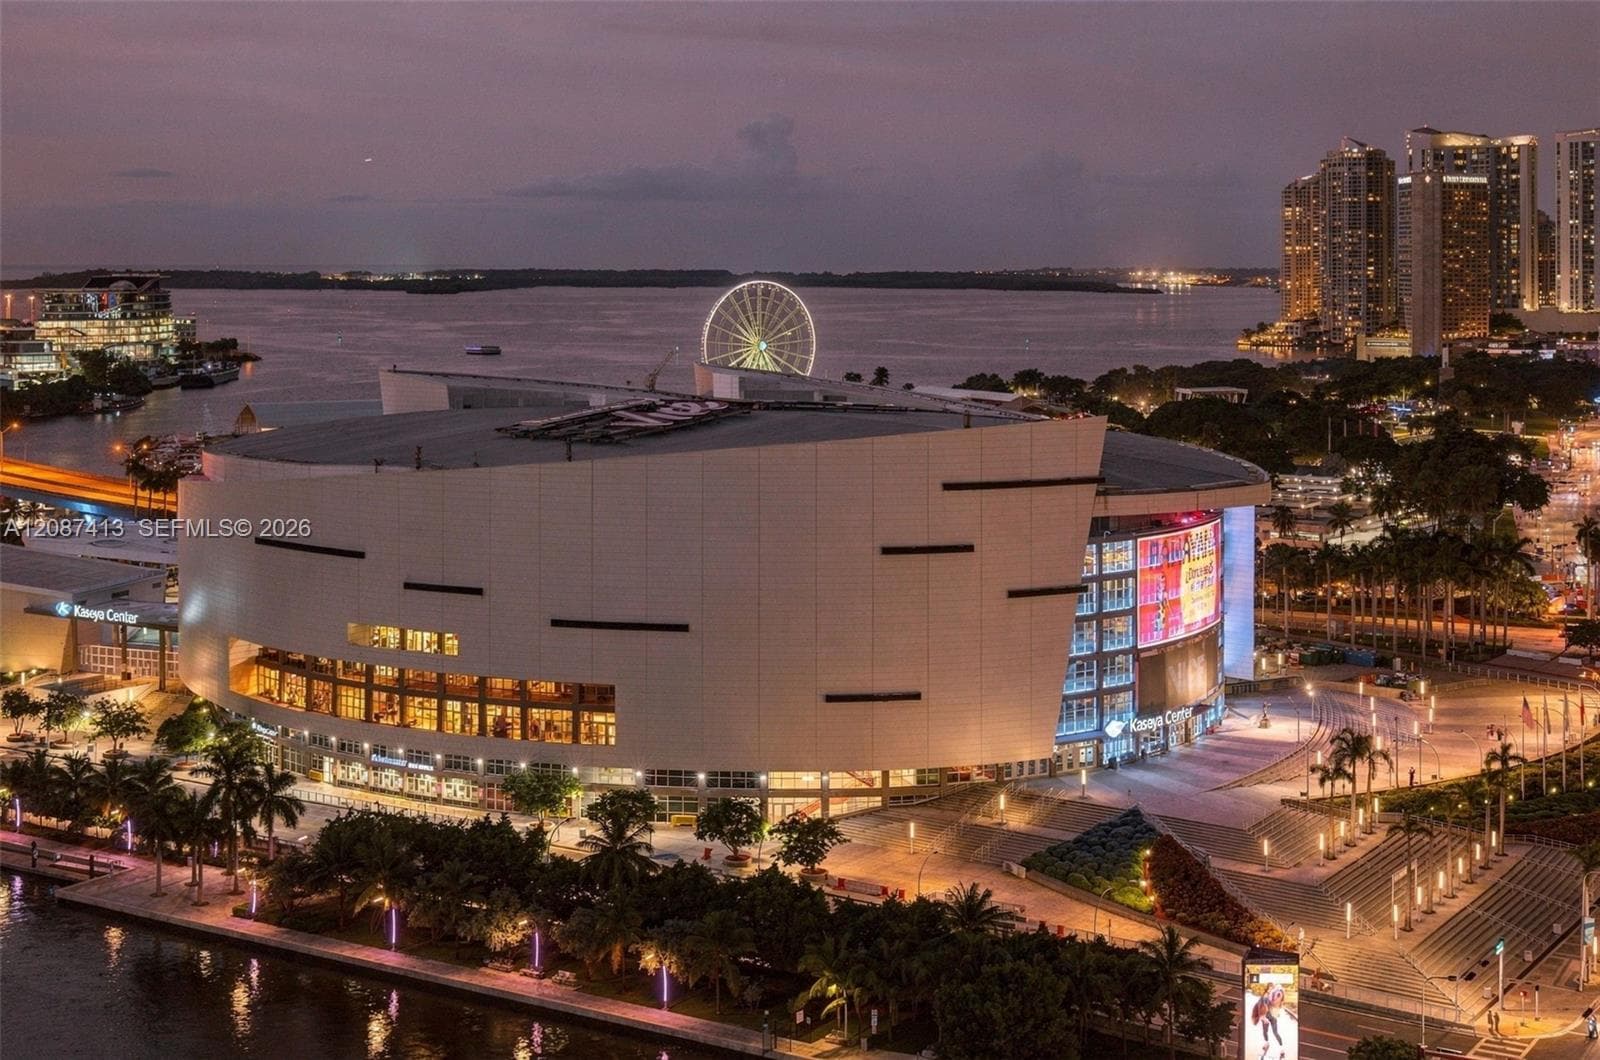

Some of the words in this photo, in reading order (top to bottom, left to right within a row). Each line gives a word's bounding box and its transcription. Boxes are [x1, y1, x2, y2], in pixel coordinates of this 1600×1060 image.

[74, 604, 105, 622] Kaseya
[106, 609, 139, 624] Center
[1130, 715, 1163, 732] Kaseya
[1165, 706, 1194, 724] Center
